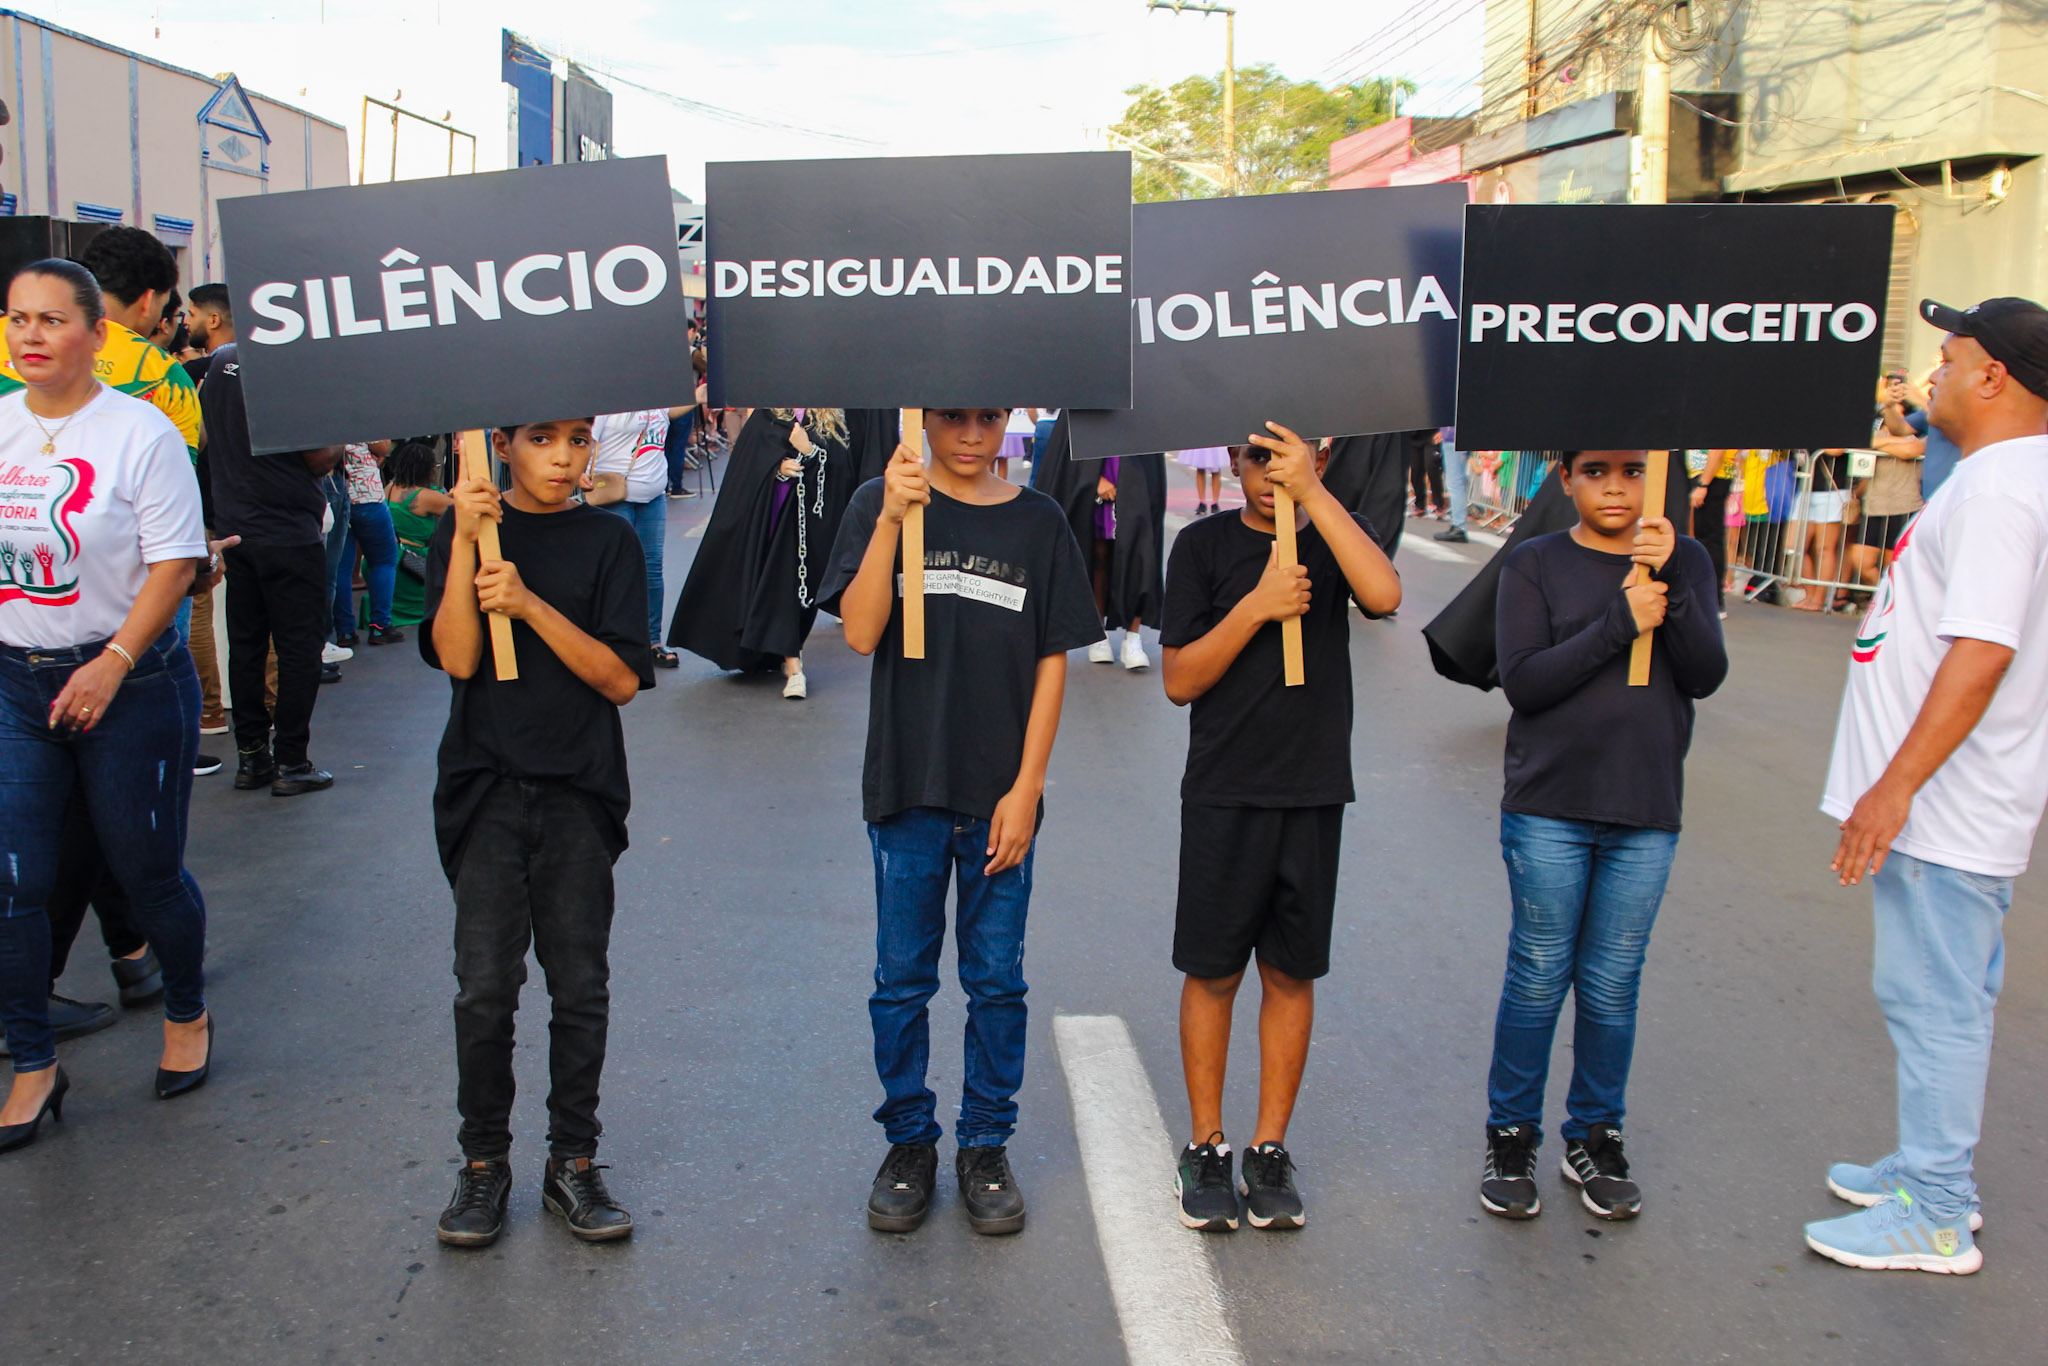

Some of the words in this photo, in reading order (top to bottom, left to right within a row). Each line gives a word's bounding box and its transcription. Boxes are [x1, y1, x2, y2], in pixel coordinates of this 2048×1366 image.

[713, 254, 1123, 299] DESIGUALDADE
[249, 244, 668, 346] SILÊNCIO
[1131, 269, 1459, 345] IOLÊNCIA
[1468, 302, 1878, 344] PRECONCEITO
[0, 461, 50, 487] ulheres
[0, 502, 38, 520] TÓRIA
[961, 554, 1027, 583] JEANS
[975, 588, 1004, 601] EIGHTY
[1003, 595, 1020, 607] FIVE
